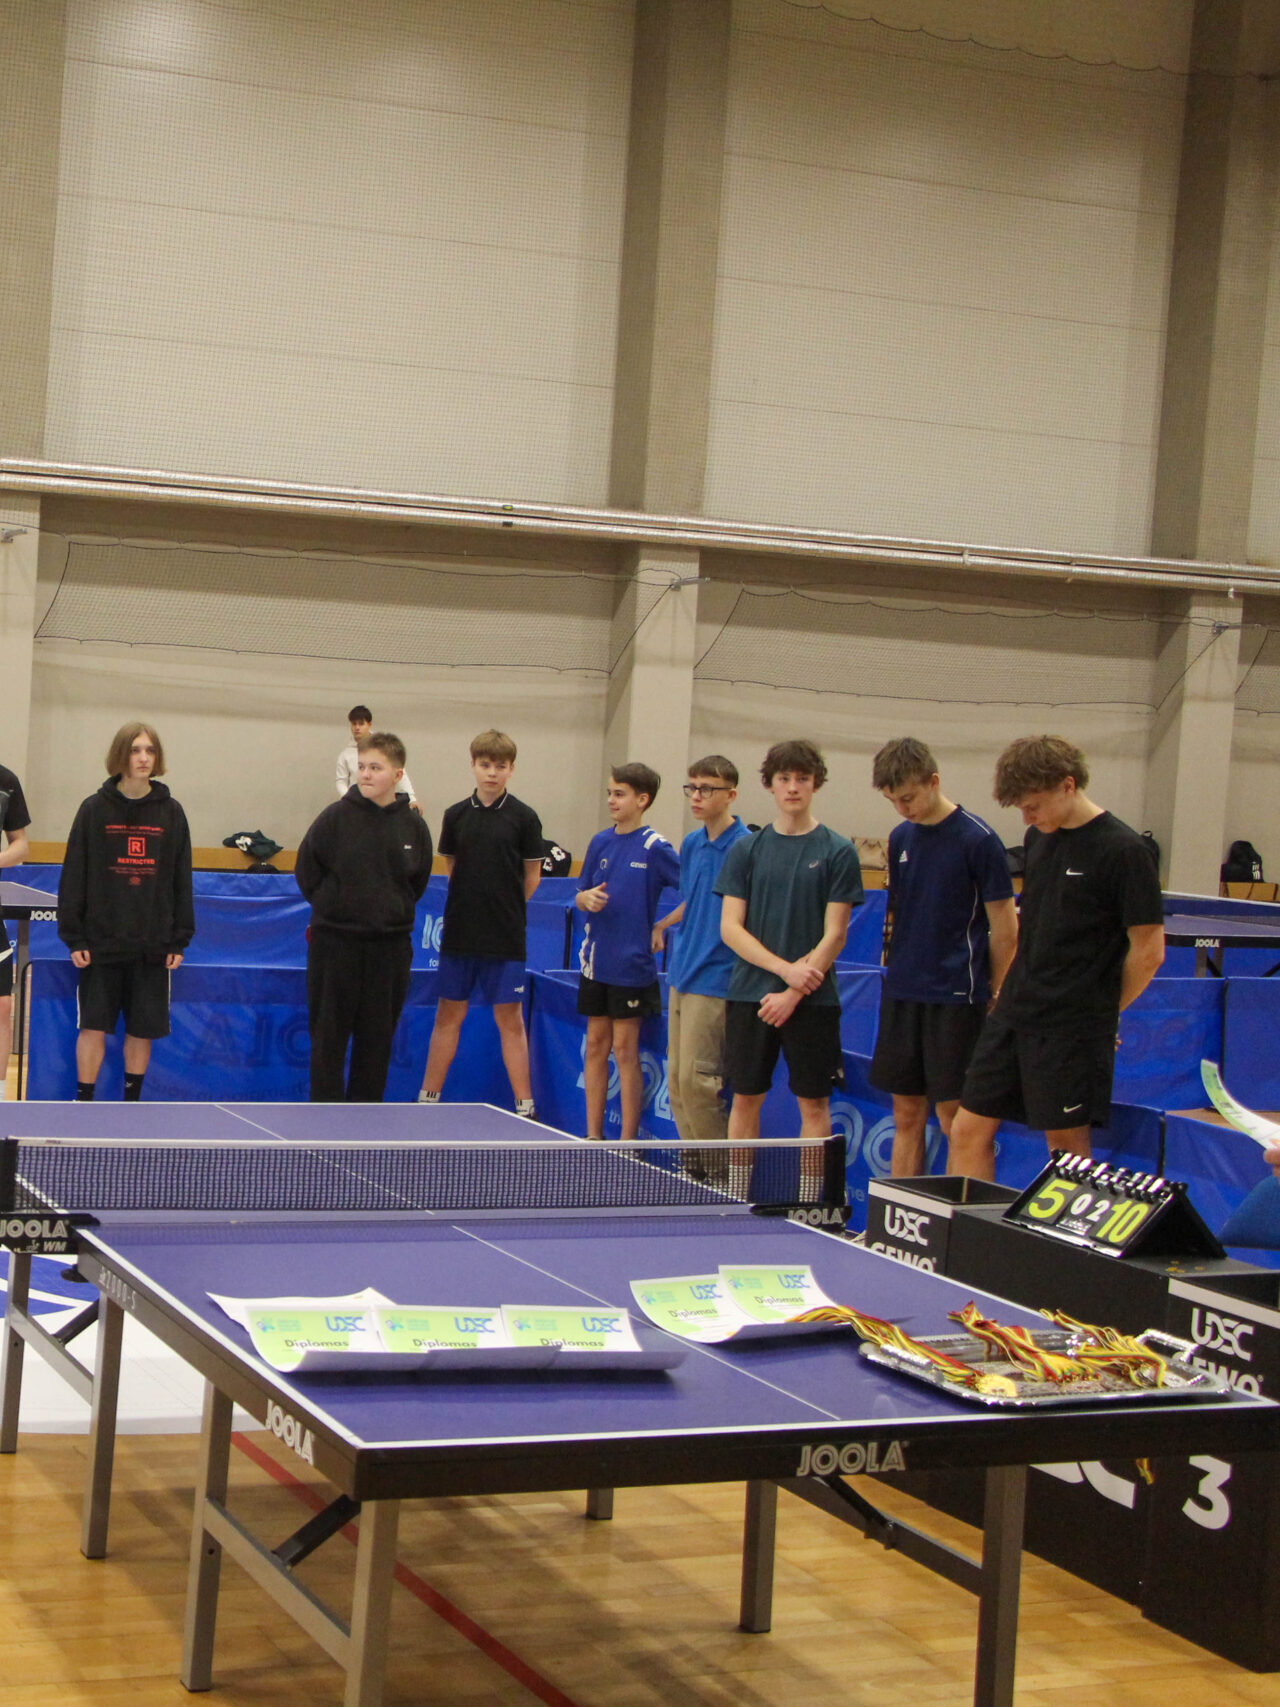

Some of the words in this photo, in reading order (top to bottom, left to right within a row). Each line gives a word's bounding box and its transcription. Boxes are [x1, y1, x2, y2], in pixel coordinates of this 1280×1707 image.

[131, 841, 141, 853] R
[117, 857, 155, 865] RESTRICTED
[30, 910, 58, 921] JOOL
[1195, 939, 1220, 948] JOOLA
[1028, 1179, 1078, 1218] 5
[1070, 1193, 1093, 1215] 0
[787, 1207, 844, 1226] JOOLA
[1086, 1200, 1111, 1222] 2
[1096, 1200, 1149, 1243] 10
[43, 1240, 68, 1253] WM
[754, 1295, 805, 1304] Diplomas
[668, 1308, 717, 1319] Diplomas
[284, 1338, 349, 1349] Diplomas
[412, 1338, 477, 1349] Diplomas
[540, 1337, 604, 1348] Diplomas
[265, 1398, 314, 1467] JOOLA
[796, 1440, 906, 1477] JOOLA
[1182, 1455, 1232, 1530] 3
